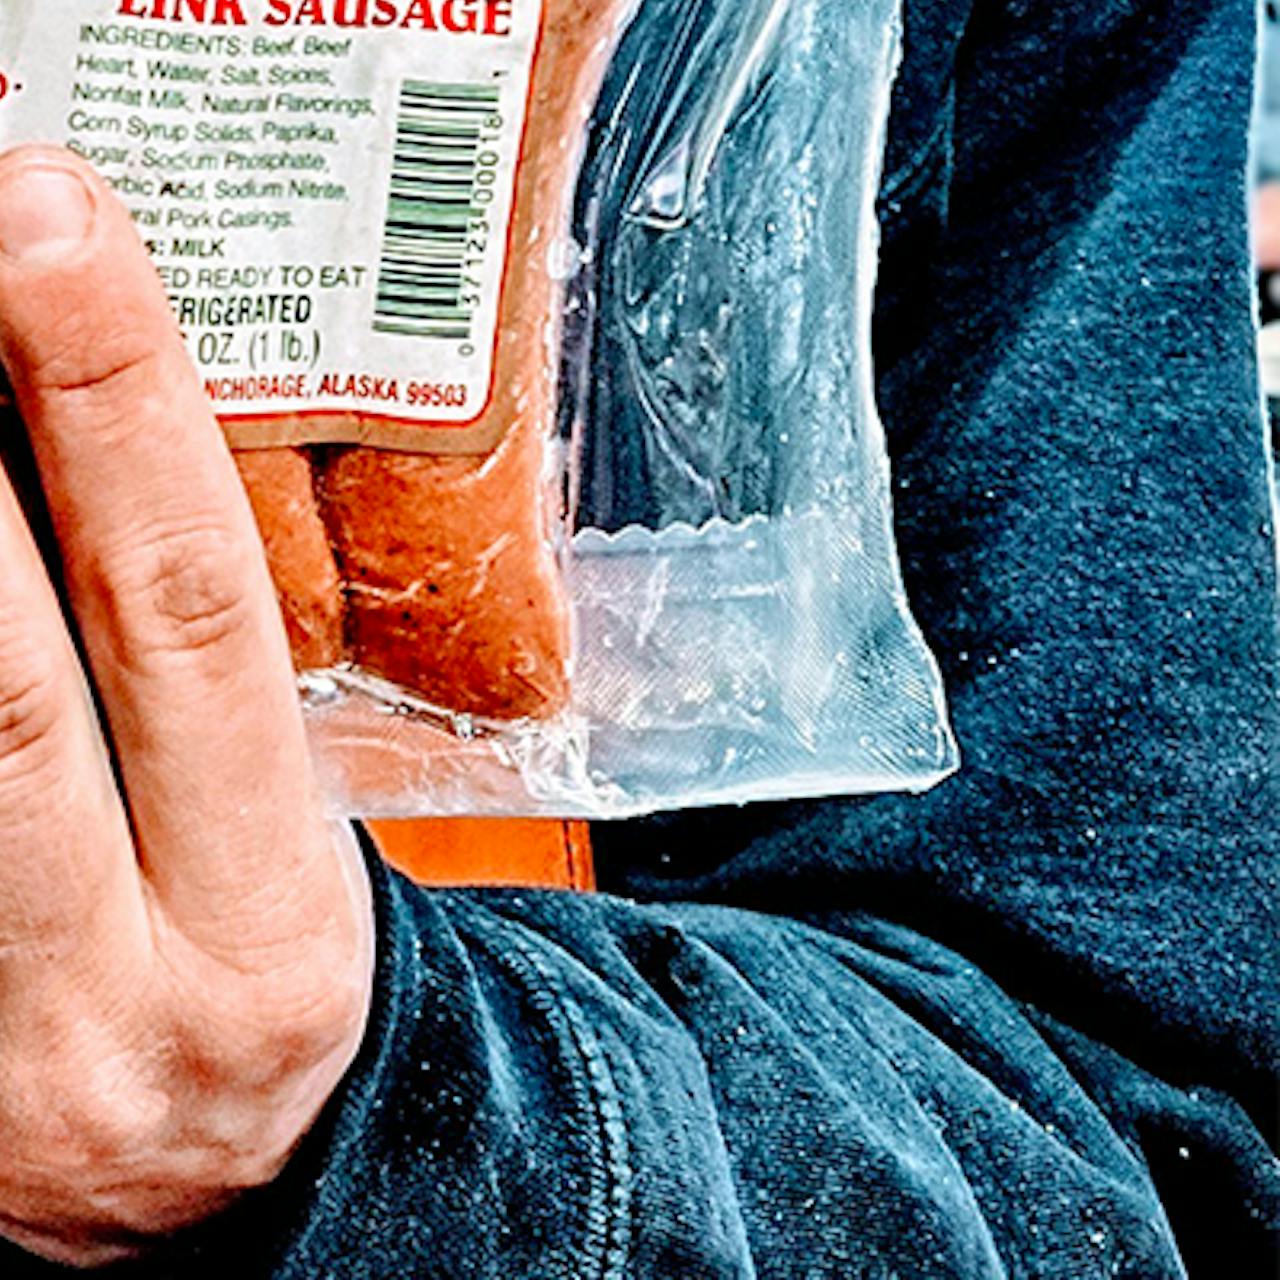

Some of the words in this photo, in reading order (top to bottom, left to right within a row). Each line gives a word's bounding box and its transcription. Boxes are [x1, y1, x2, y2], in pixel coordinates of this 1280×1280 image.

[78, 23, 248, 57] INGREDIENTS:
[302, 36, 353, 58] Beef
[76, 53, 138, 79] Heart,
[145, 59, 214, 87] Water,
[219, 64, 262, 88] Salt,
[267, 64, 336, 88] Spices,
[71, 82, 142, 108] Nonfat
[147, 89, 195, 113] Milk,
[201, 92, 272, 115] Natural
[274, 92, 376, 120] Flavorings,
[67, 110, 122, 133] Corn
[126, 114, 189, 142] Syrup
[261, 120, 340, 146] Paprika,
[140, 147, 219, 171] Sodium
[223, 149, 331, 173] Phosphate,
[473, 114, 505, 204] 00018
[103, 174, 154, 197] orbic
[214, 179, 285, 200] Sodium
[288, 179, 351, 203] Nitrite,
[166, 207, 213, 228] Pork
[169, 238, 227, 258] MILK
[460, 220, 492, 309] 37123
[197, 266, 275, 290] READY
[279, 265, 316, 288] TO
[318, 265, 369, 289] EAT
[168, 294, 314, 327] RIGERATED
[196, 331, 241, 367] OZ.
[248, 328, 272, 371] (1
[279, 328, 322, 371] lb.)
[457, 342, 476, 358] 0
[204, 373, 312, 403] NCHORAGE,
[317, 374, 399, 404] ALASKA
[404, 383, 469, 408] 99503
